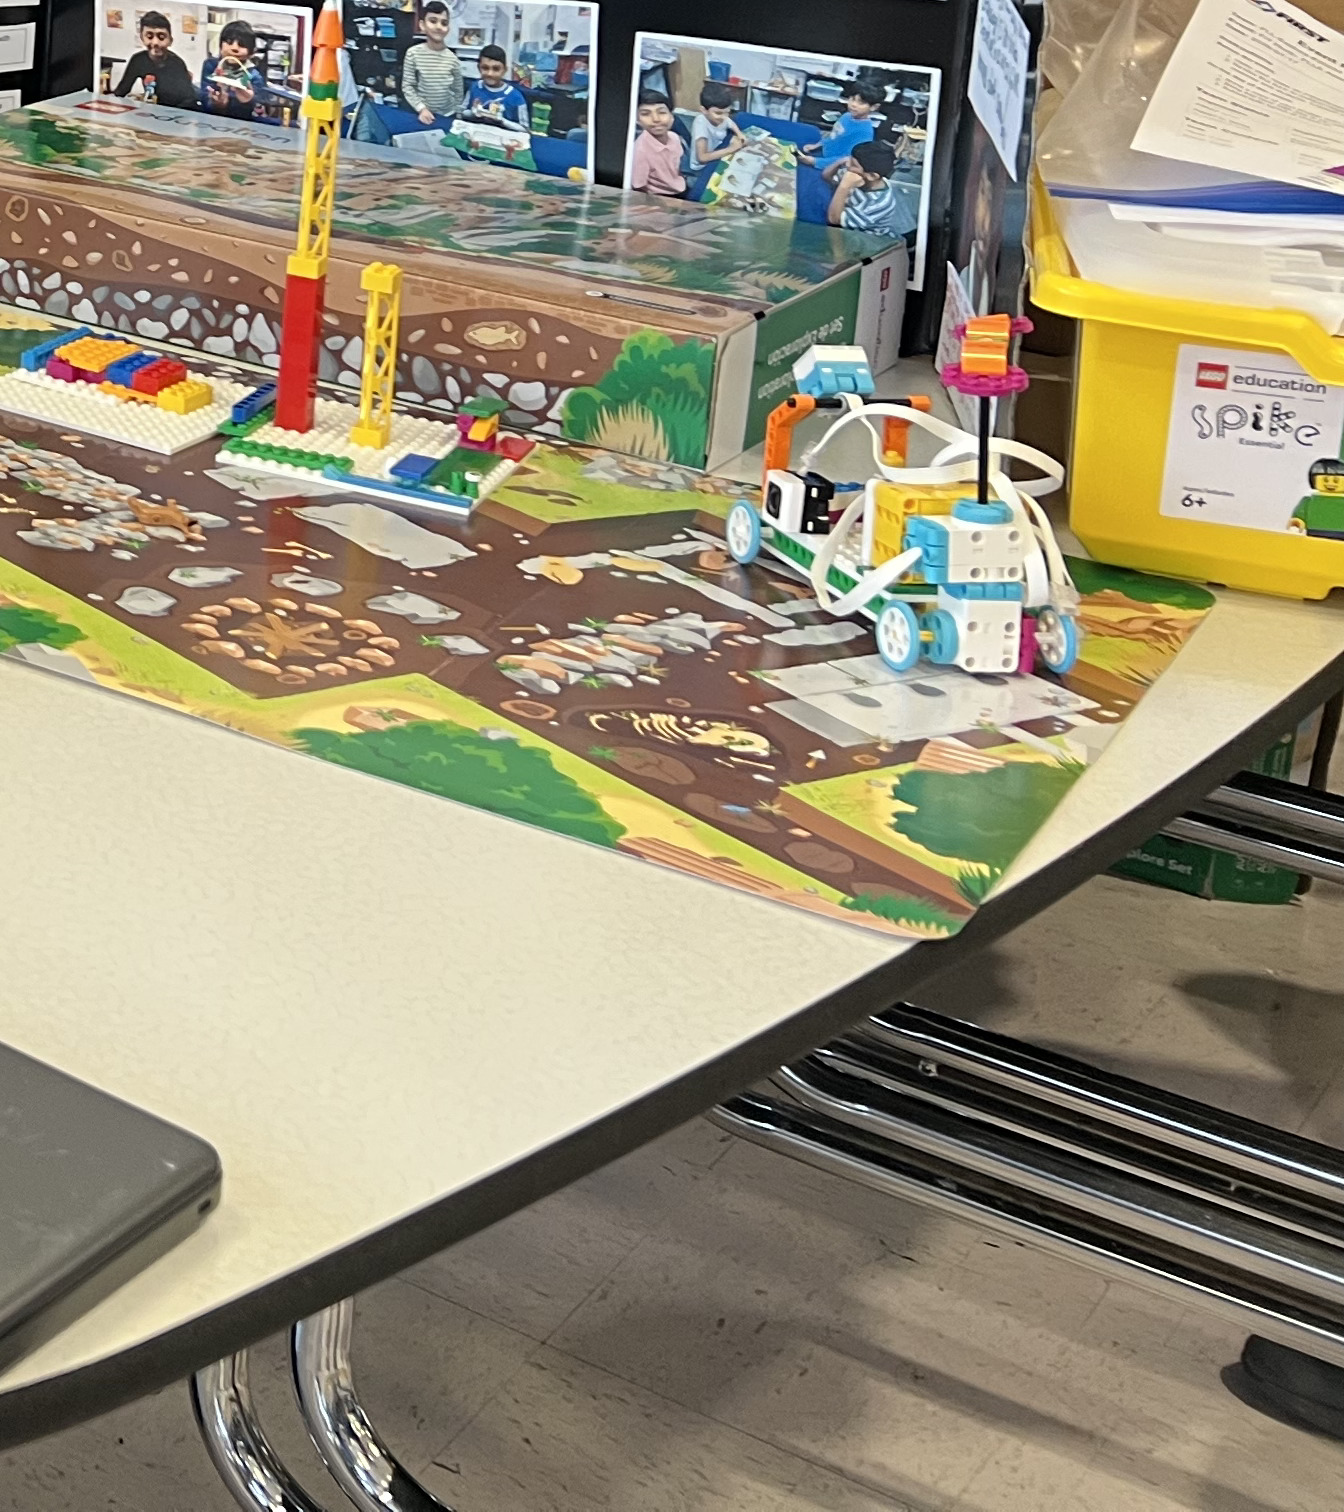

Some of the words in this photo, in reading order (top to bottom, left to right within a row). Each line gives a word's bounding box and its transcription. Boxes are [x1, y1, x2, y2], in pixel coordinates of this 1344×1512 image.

[1276, 11, 1330, 43] FIRST
[1232, 373, 1327, 395] education
[1238, 437, 1285, 449] Essential
[1181, 494, 1207, 507] 6+
[1167, 858, 1193, 876] Set
